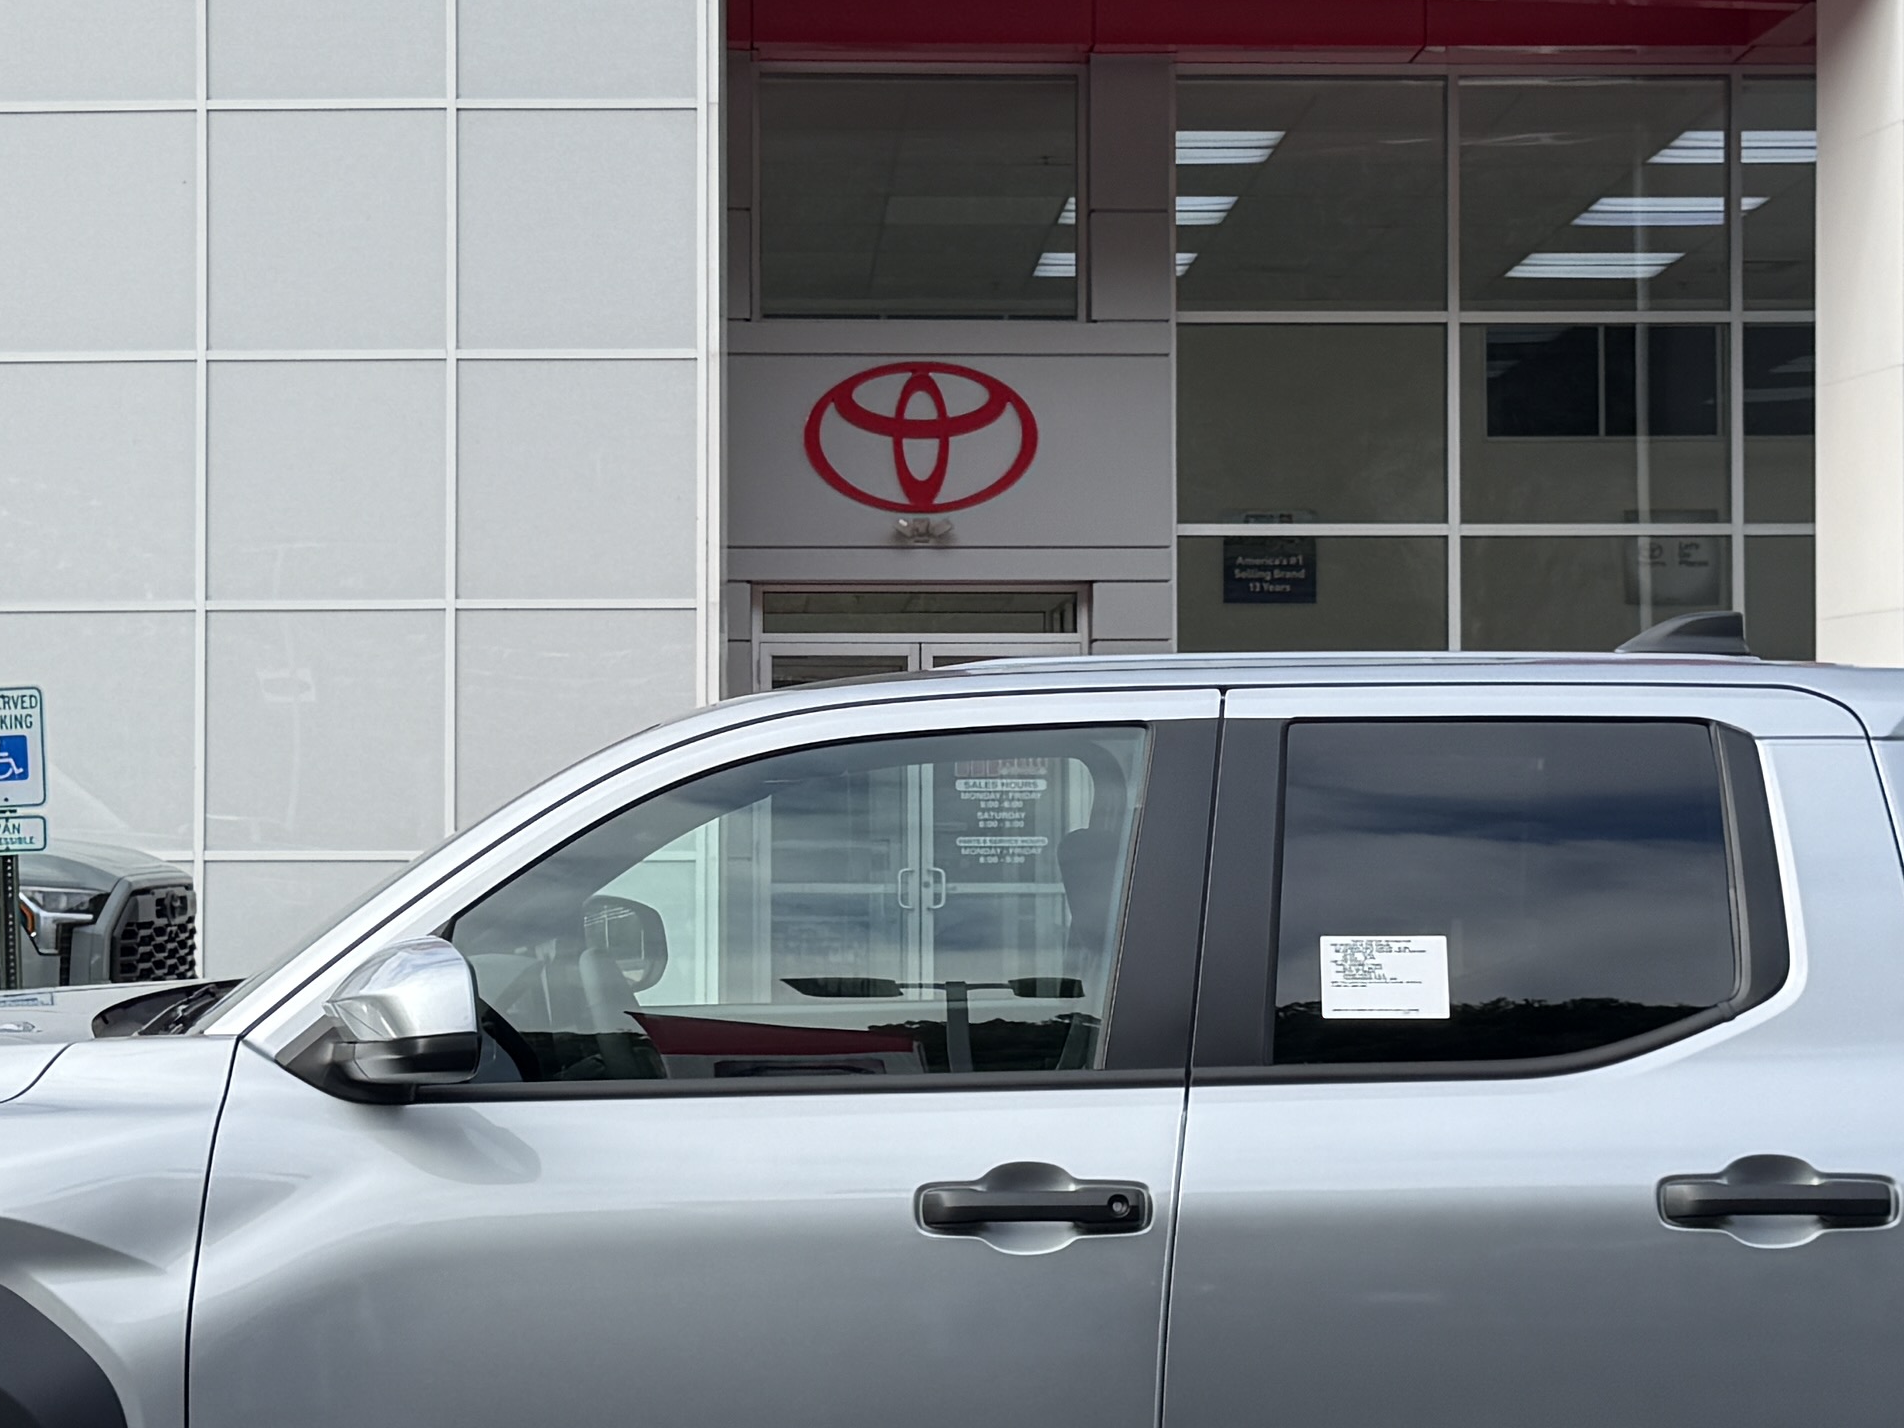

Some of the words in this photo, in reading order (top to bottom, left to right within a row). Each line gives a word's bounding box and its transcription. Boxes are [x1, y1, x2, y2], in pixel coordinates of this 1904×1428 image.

[963, 780, 998, 789] SALES
[1000, 780, 1039, 789] HOURS
[976, 812, 1026, 820] SATURDAY
